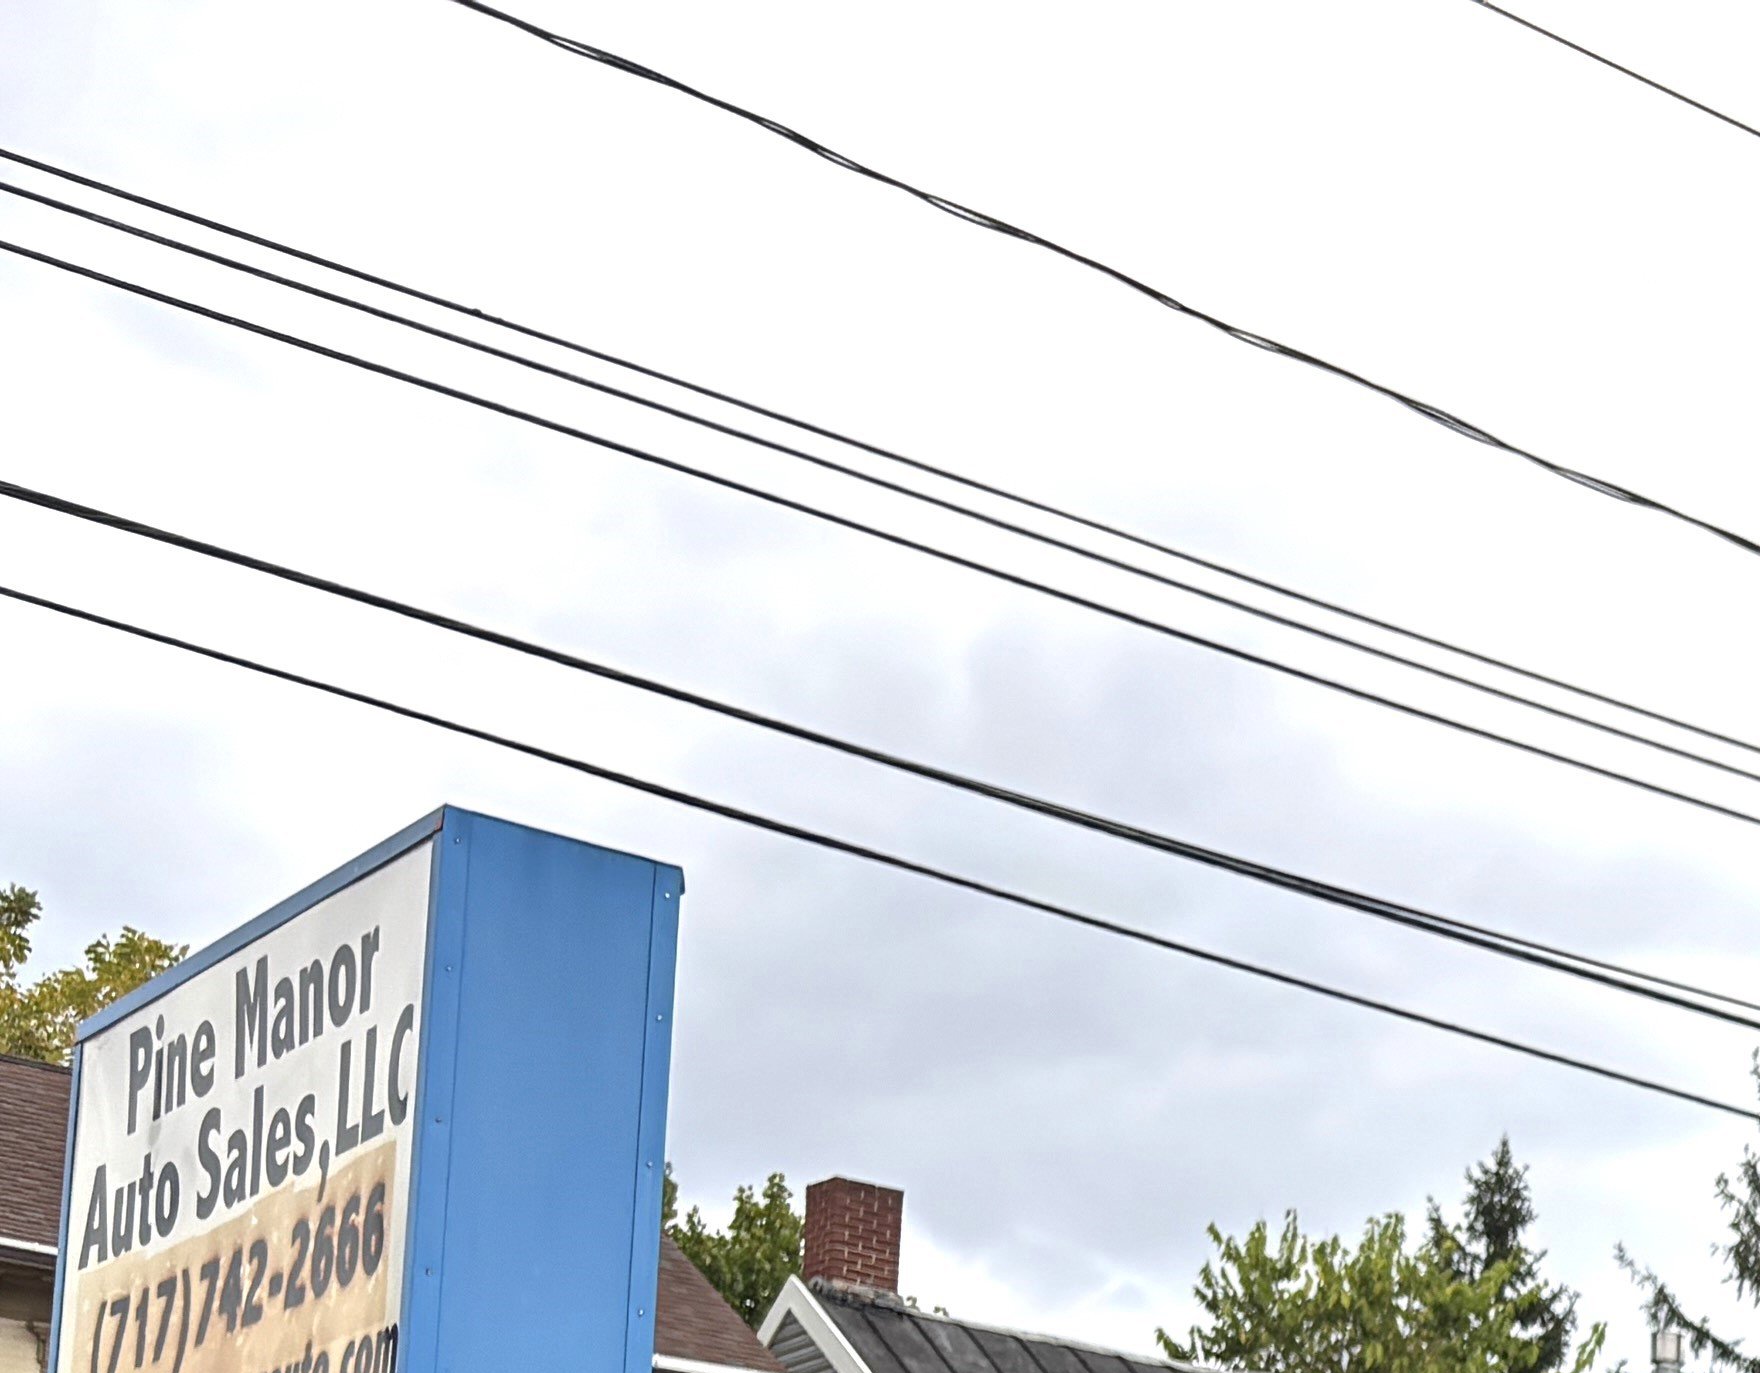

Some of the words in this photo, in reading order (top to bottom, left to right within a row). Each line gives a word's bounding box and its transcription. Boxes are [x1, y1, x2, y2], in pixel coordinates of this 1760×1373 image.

[127, 1013, 216, 1136] Pine
[234, 924, 380, 1080] Manor
[78, 1152, 180, 1271] Auto
